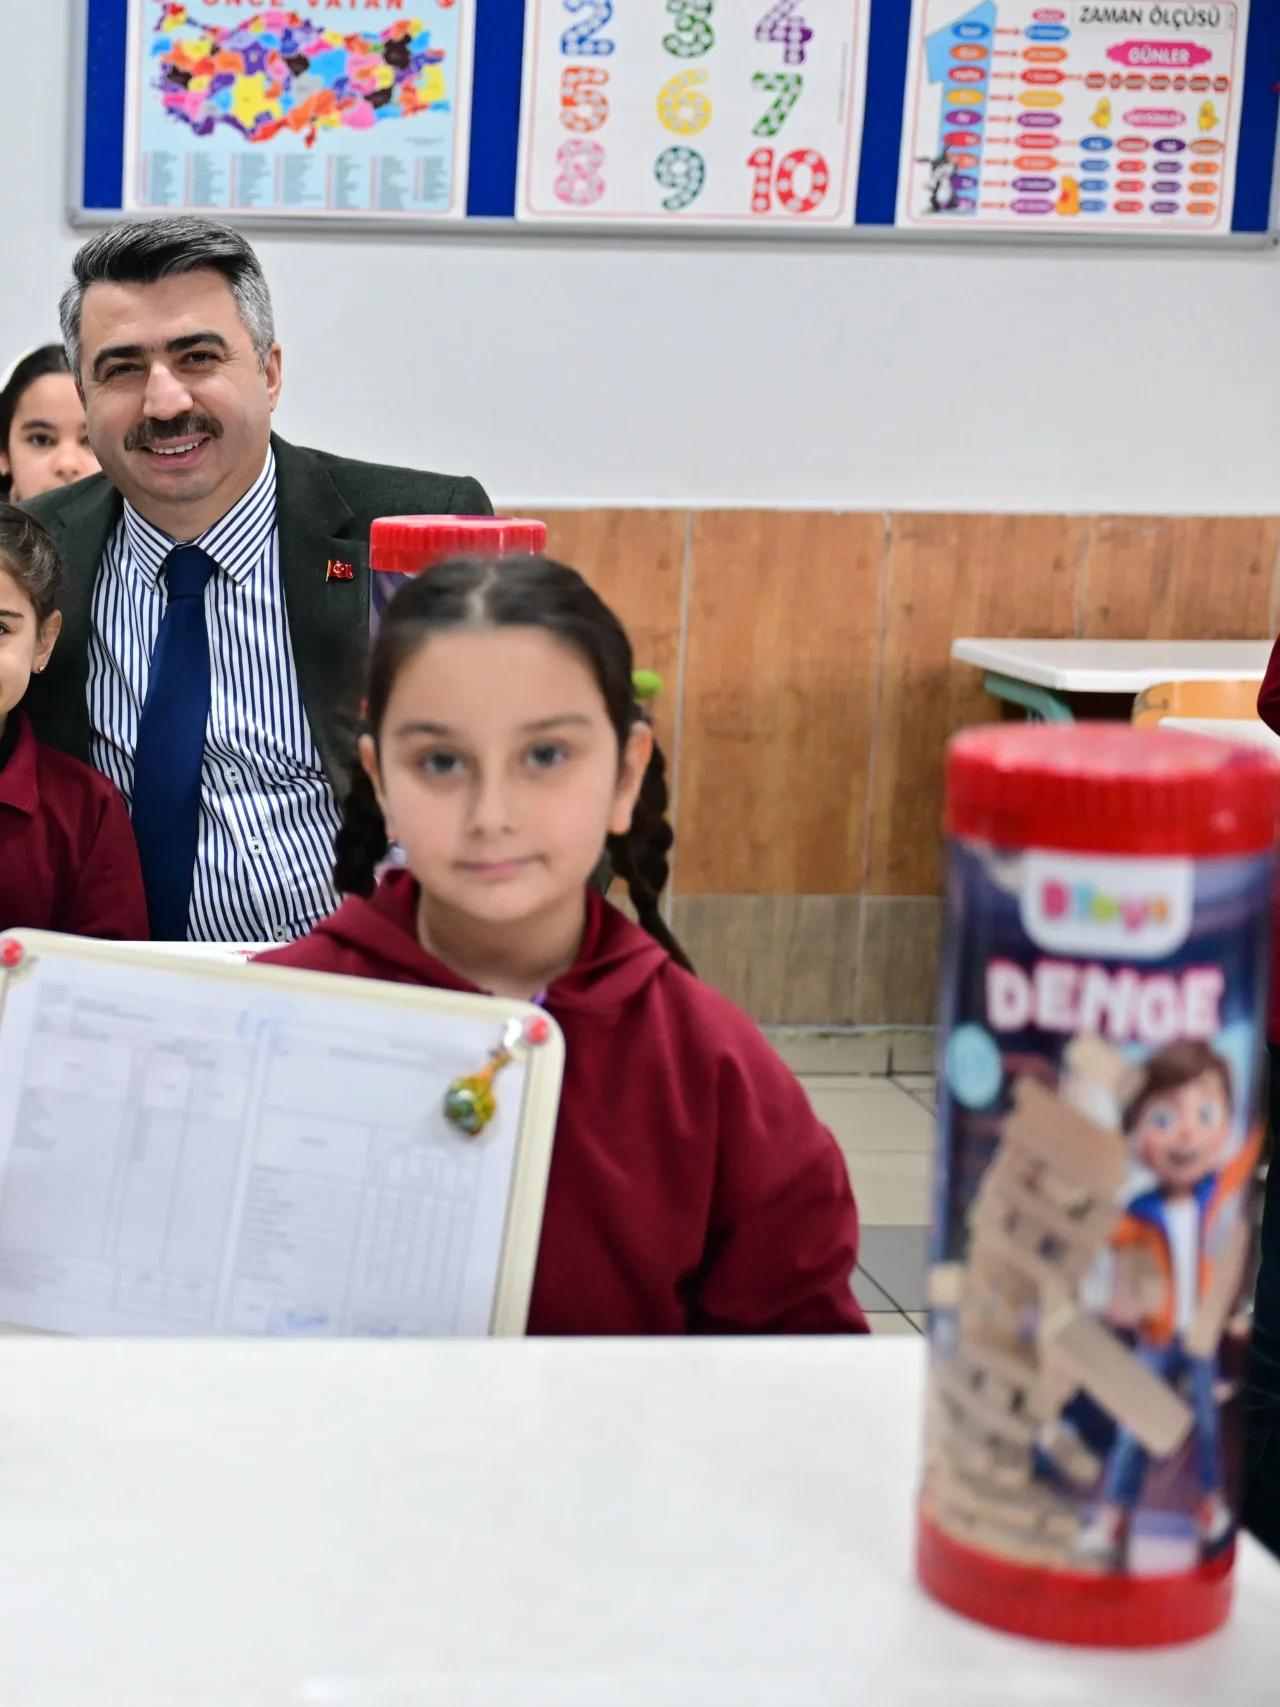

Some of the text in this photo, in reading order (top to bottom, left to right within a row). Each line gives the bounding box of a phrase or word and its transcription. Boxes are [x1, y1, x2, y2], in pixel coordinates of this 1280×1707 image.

[560, 0, 814, 65] 2 3 4
[1080, 6, 1142, 24] ZAMAN
[1149, 4, 1221, 31] ÖLÇÜSÜ
[1128, 44, 1190, 65] GÜNLER
[559, 65, 610, 134] 5
[656, 67, 712, 136] 6
[751, 70, 804, 137] 7
[553, 138, 829, 214] 8 9 10
